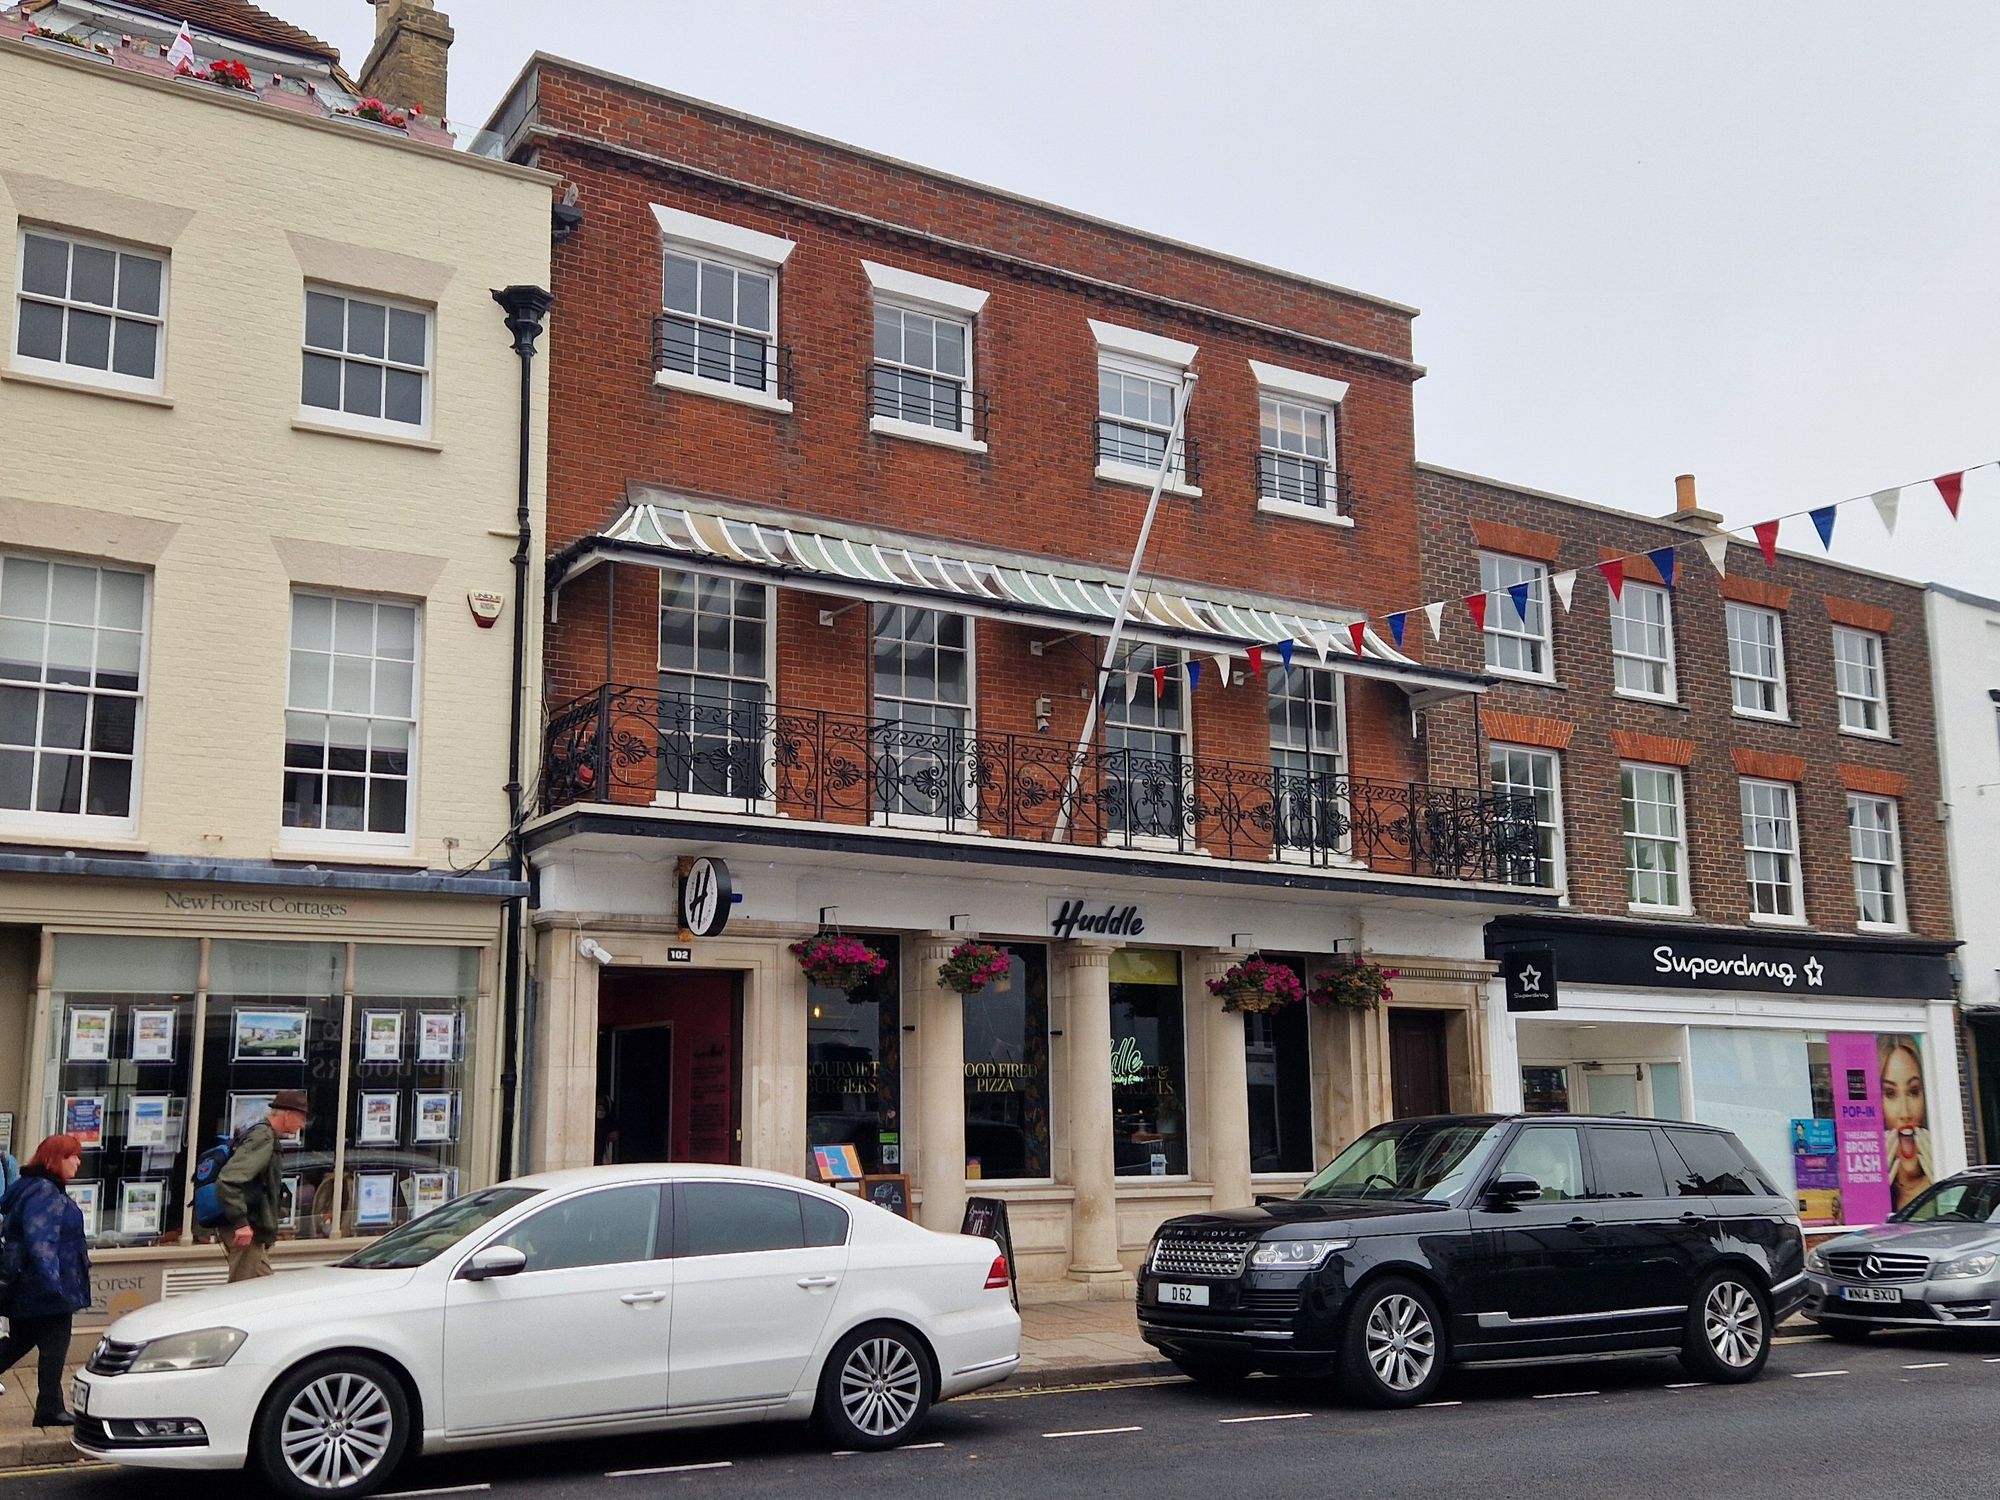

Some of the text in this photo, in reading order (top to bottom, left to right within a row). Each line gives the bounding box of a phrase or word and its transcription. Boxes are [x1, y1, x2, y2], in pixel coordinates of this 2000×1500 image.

[165, 891, 347, 918] New Forest Cottages
[1052, 900, 1144, 940] Huddle
[671, 950, 689, 959] 102
[1653, 945, 1797, 986] Superdrug
[963, 1062, 1038, 1078] OOD FIRED
[977, 1078, 1015, 1092] PIZZA
[1842, 1105, 1876, 1118] POP-IN
[1845, 1141, 1880, 1154] BROWS
[1847, 1154, 1881, 1173] LASH
[1848, 1173, 1882, 1184] PIERCING
[1873, 1289, 1897, 1301] BXU
